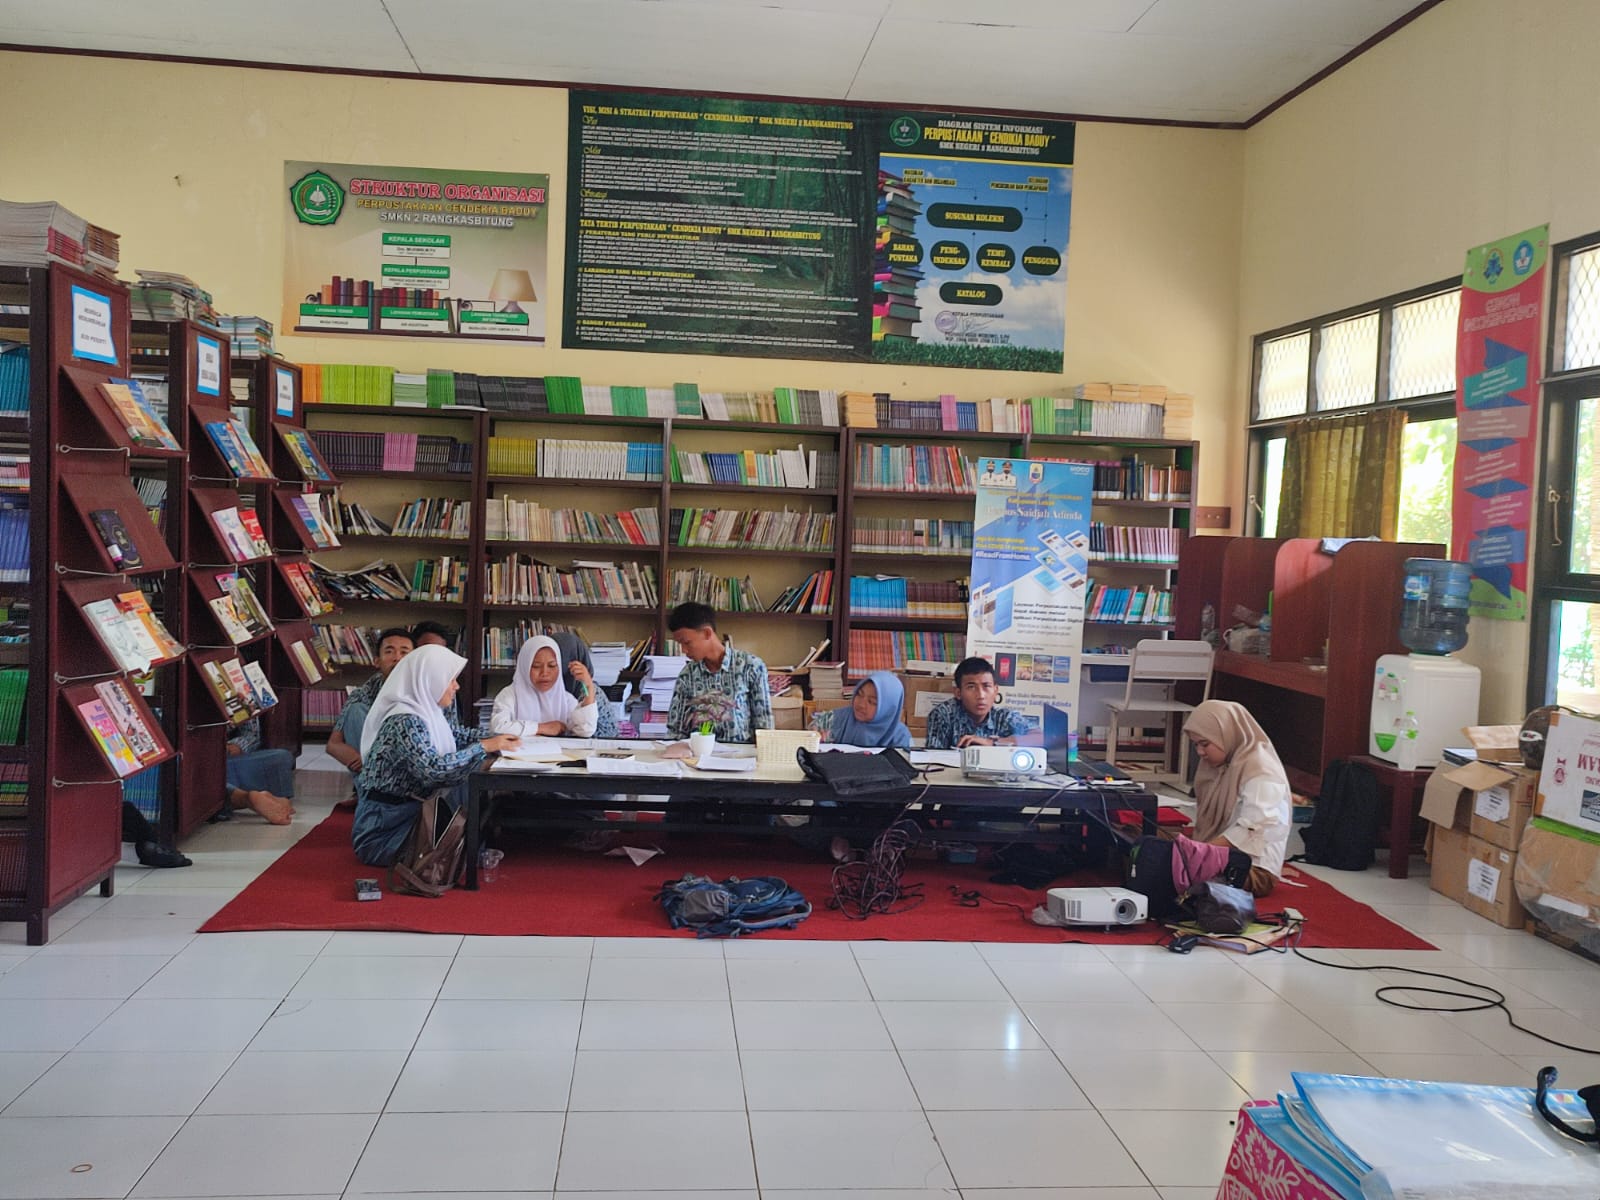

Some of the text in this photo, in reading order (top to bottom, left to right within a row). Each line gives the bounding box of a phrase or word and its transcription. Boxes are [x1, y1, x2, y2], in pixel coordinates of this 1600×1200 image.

[620, 107, 650, 117] STRATEGI
[651, 109, 698, 120] PERPUSTAKAAN
[734, 114, 754, 124] BADUY
[759, 116, 773, 125] SMK
[774, 117, 797, 127] NEGERI
[803, 119, 854, 130] RANGKASBITUNG
[938, 119, 1043, 134] DIAGRAM SISTEM INFORMASI
[924, 127, 1050, 147] PERPUSTAKAAN CENDIKIA BADUY
[939, 141, 953, 150] SMK
[955, 142, 980, 152] NEGERI
[986, 143, 1040, 155] RANGKASBITUNG
[350, 178, 545, 203] STRUKTUR ORGANISASI
[356, 199, 538, 218] PERPUSTAKAAN CENDEKIA BADUY
[380, 211, 515, 228] SMKN 2 RANGKASBITUNG
[944, 210, 1005, 223] SUSUNAN KOLEKSI
[580, 219, 595, 227] TATA
[596, 220, 618, 228] TERTIB
[619, 221, 667, 232] PERPUSTAKAAN
[702, 226, 722, 234] BADUY
[770, 230, 822, 240] RANGKASBITUNG
[892, 243, 915, 252] BAHAN
[986, 248, 1006, 256] TEMU
[888, 254, 918, 263] PUSTAKA
[981, 258, 1011, 268] KEMBALI
[1023, 256, 1059, 266] PENGGUNA
[956, 288, 986, 299] KATALOG
